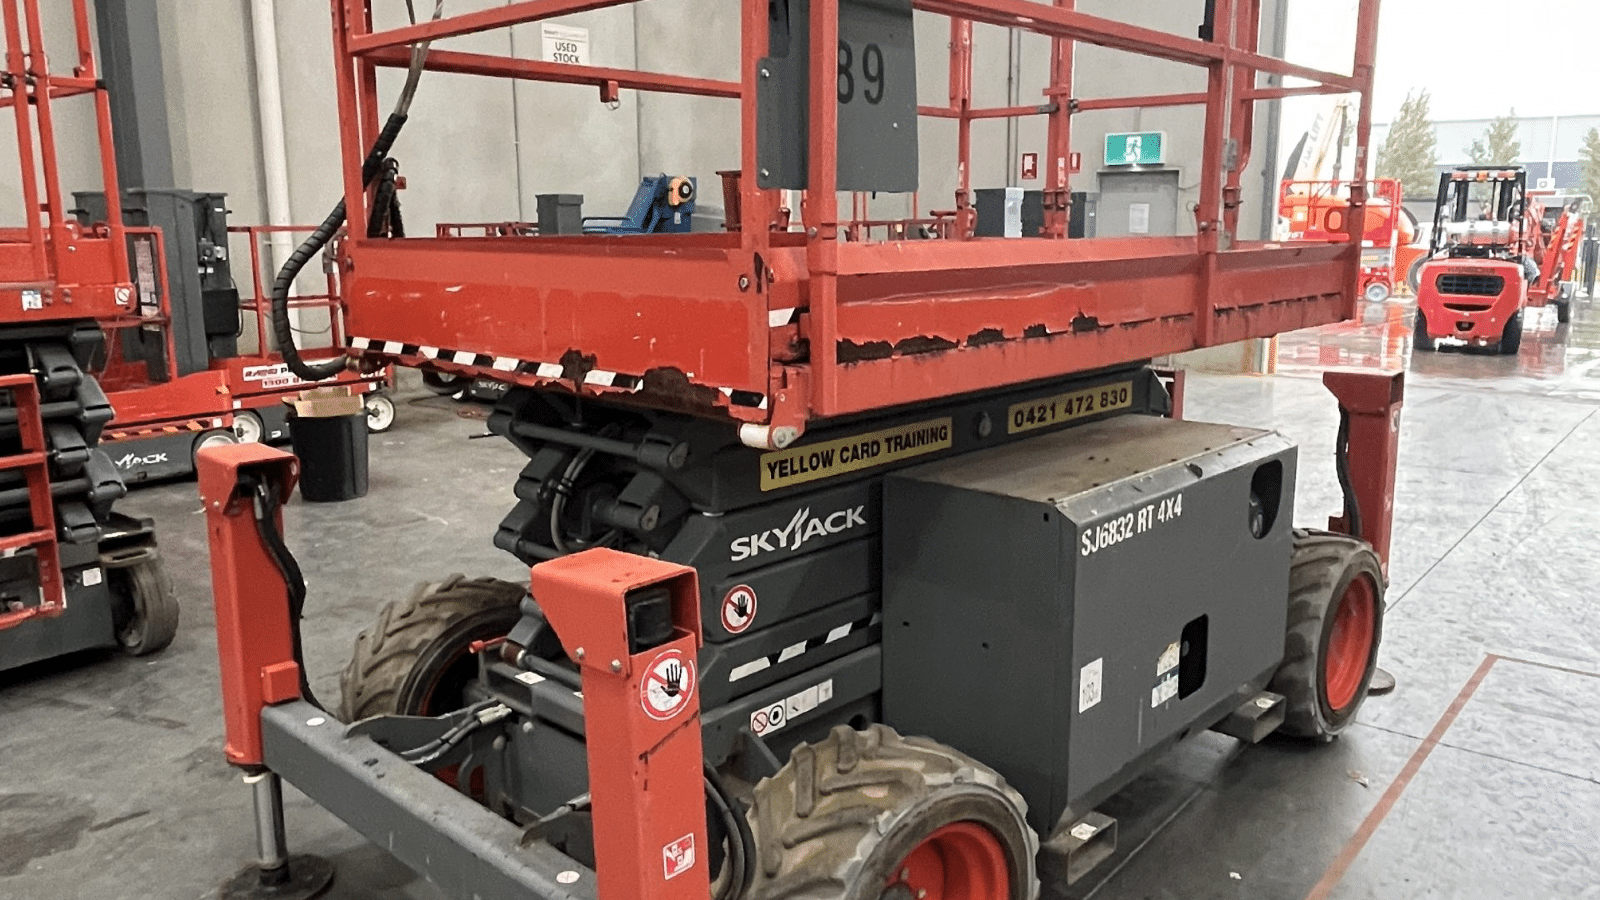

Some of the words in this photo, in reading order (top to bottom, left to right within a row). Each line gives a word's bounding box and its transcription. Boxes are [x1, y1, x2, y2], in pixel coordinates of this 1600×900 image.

[553, 52, 580, 63] STOCK
[554, 41, 578, 53] USED
[1013, 402, 1057, 428] 0421
[1064, 395, 1095, 416] 472
[1100, 387, 1128, 408] 830
[766, 449, 835, 480] YELLOW
[839, 439, 882, 464] CARD
[884, 424, 949, 454] TRAINING
[729, 504, 868, 562] SKYJACK
[1081, 512, 1135, 556] SJ6832
[1137, 504, 1156, 534] RT
[1157, 493, 1184, 523] 4X4
